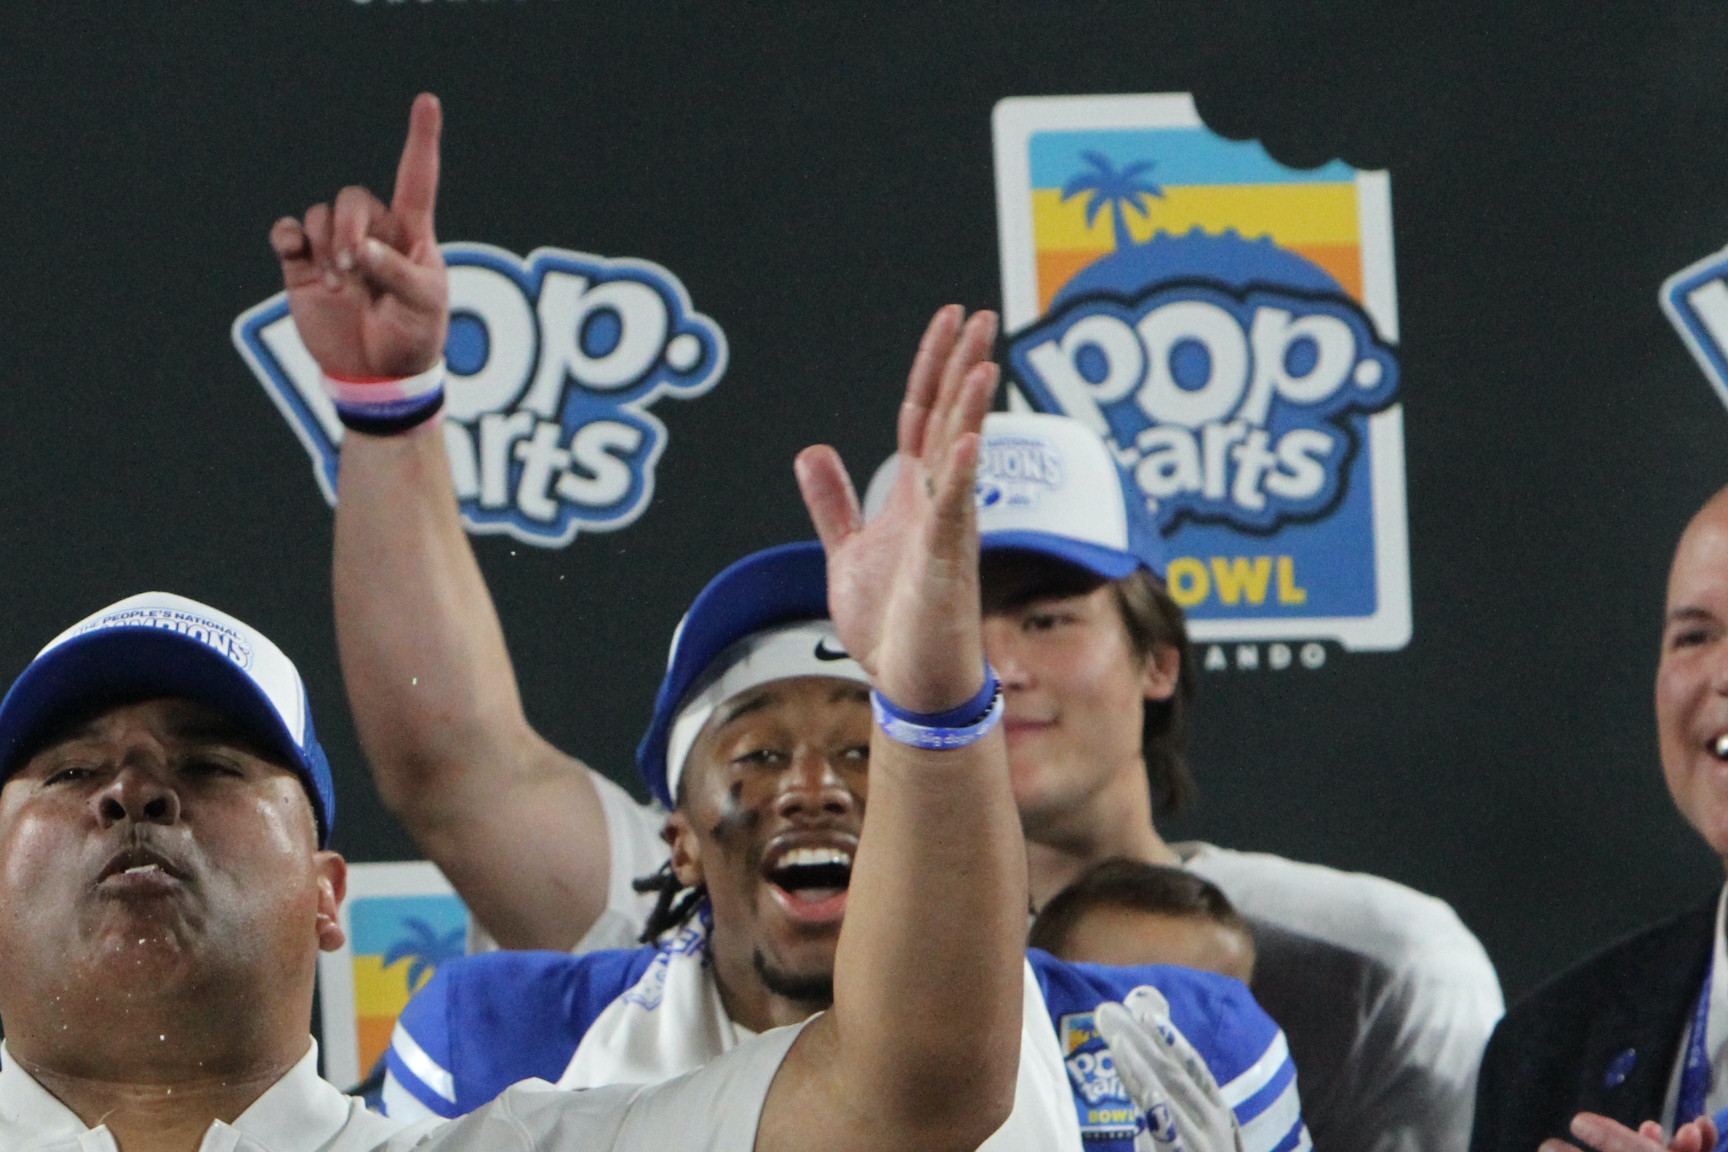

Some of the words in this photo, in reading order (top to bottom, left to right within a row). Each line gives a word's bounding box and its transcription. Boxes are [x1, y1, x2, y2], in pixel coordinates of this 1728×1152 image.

[445, 411, 642, 522] rts
[1114, 421, 1335, 511] arts
[1167, 556, 1307, 606] OWL
[102, 609, 173, 625] PEOPLE'S
[174, 612, 241, 640] NATIONAL
[1203, 643, 1328, 671] ANDO
